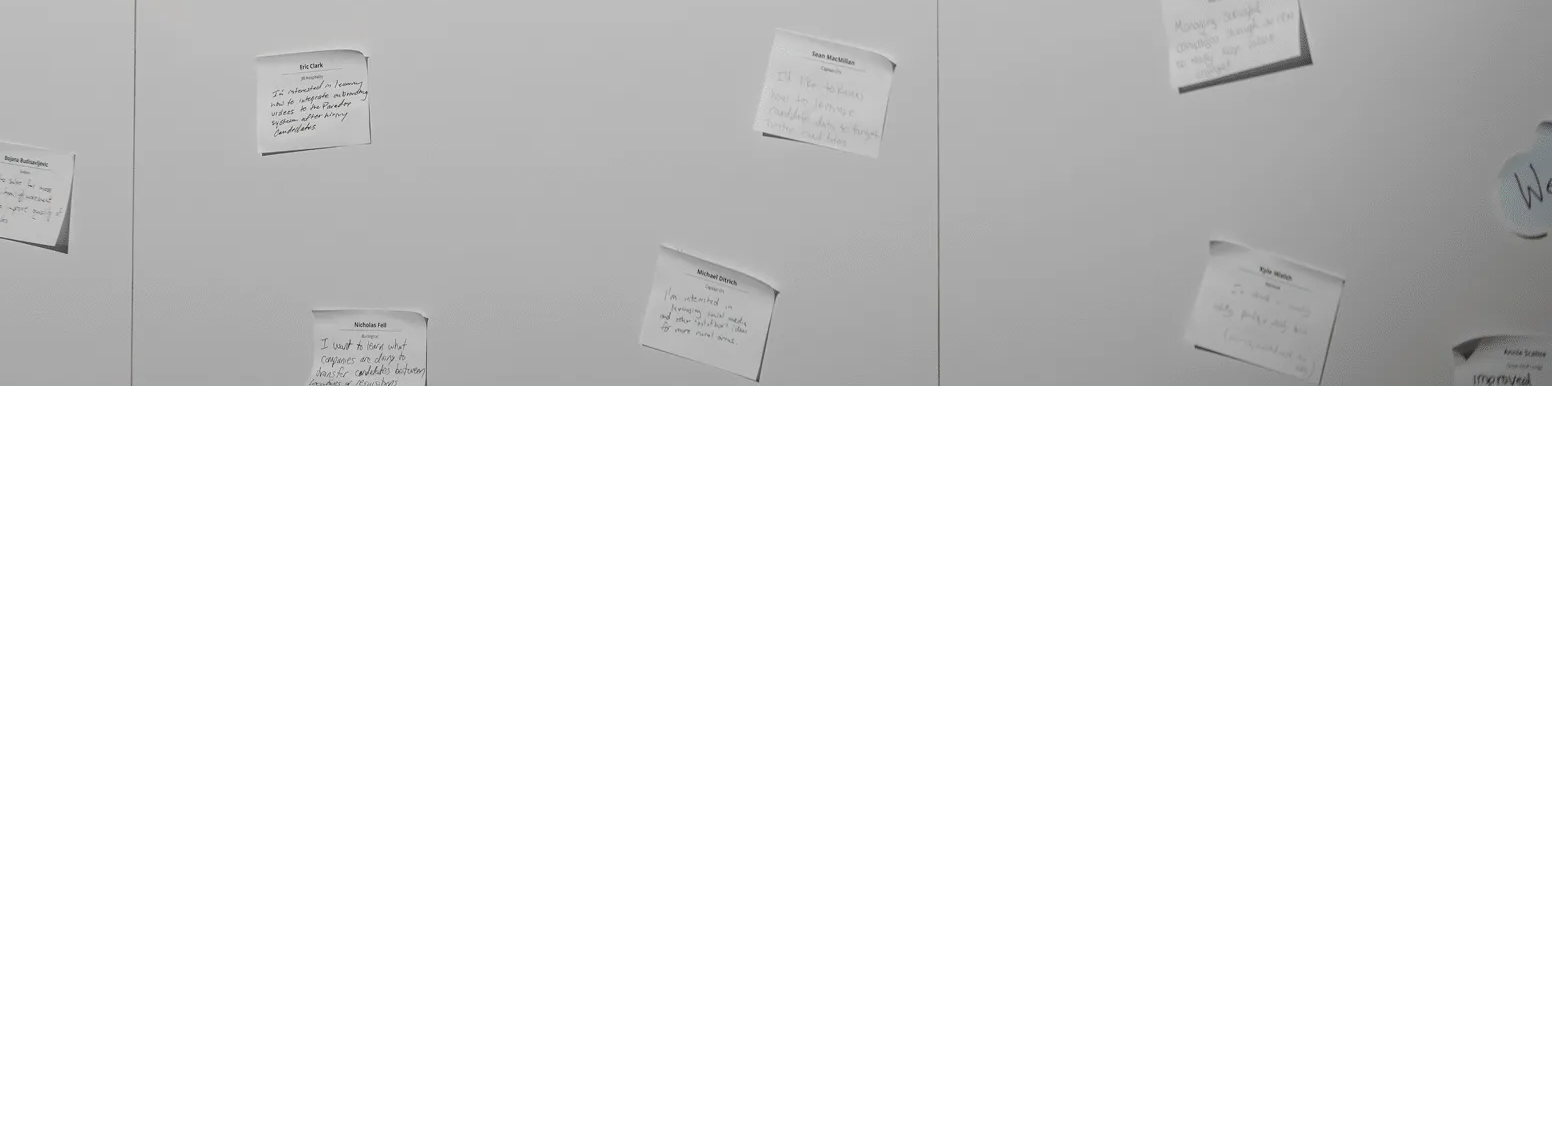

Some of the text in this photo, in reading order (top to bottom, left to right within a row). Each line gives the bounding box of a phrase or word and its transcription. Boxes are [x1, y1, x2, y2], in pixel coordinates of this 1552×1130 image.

[812, 51, 856, 66] Sean MacMillan
[288, 80, 324, 94] interested
[335, 79, 363, 90] learning
[288, 98, 294, 106] to
[299, 92, 329, 104] integrate
[271, 112, 348, 129] system after hiring
[697, 269, 738, 286] Michael Ditrich
[321, 338, 408, 350] I want to learn what
[374, 352, 395, 365] doing
[399, 351, 406, 361] to
[316, 366, 349, 378] transfer
